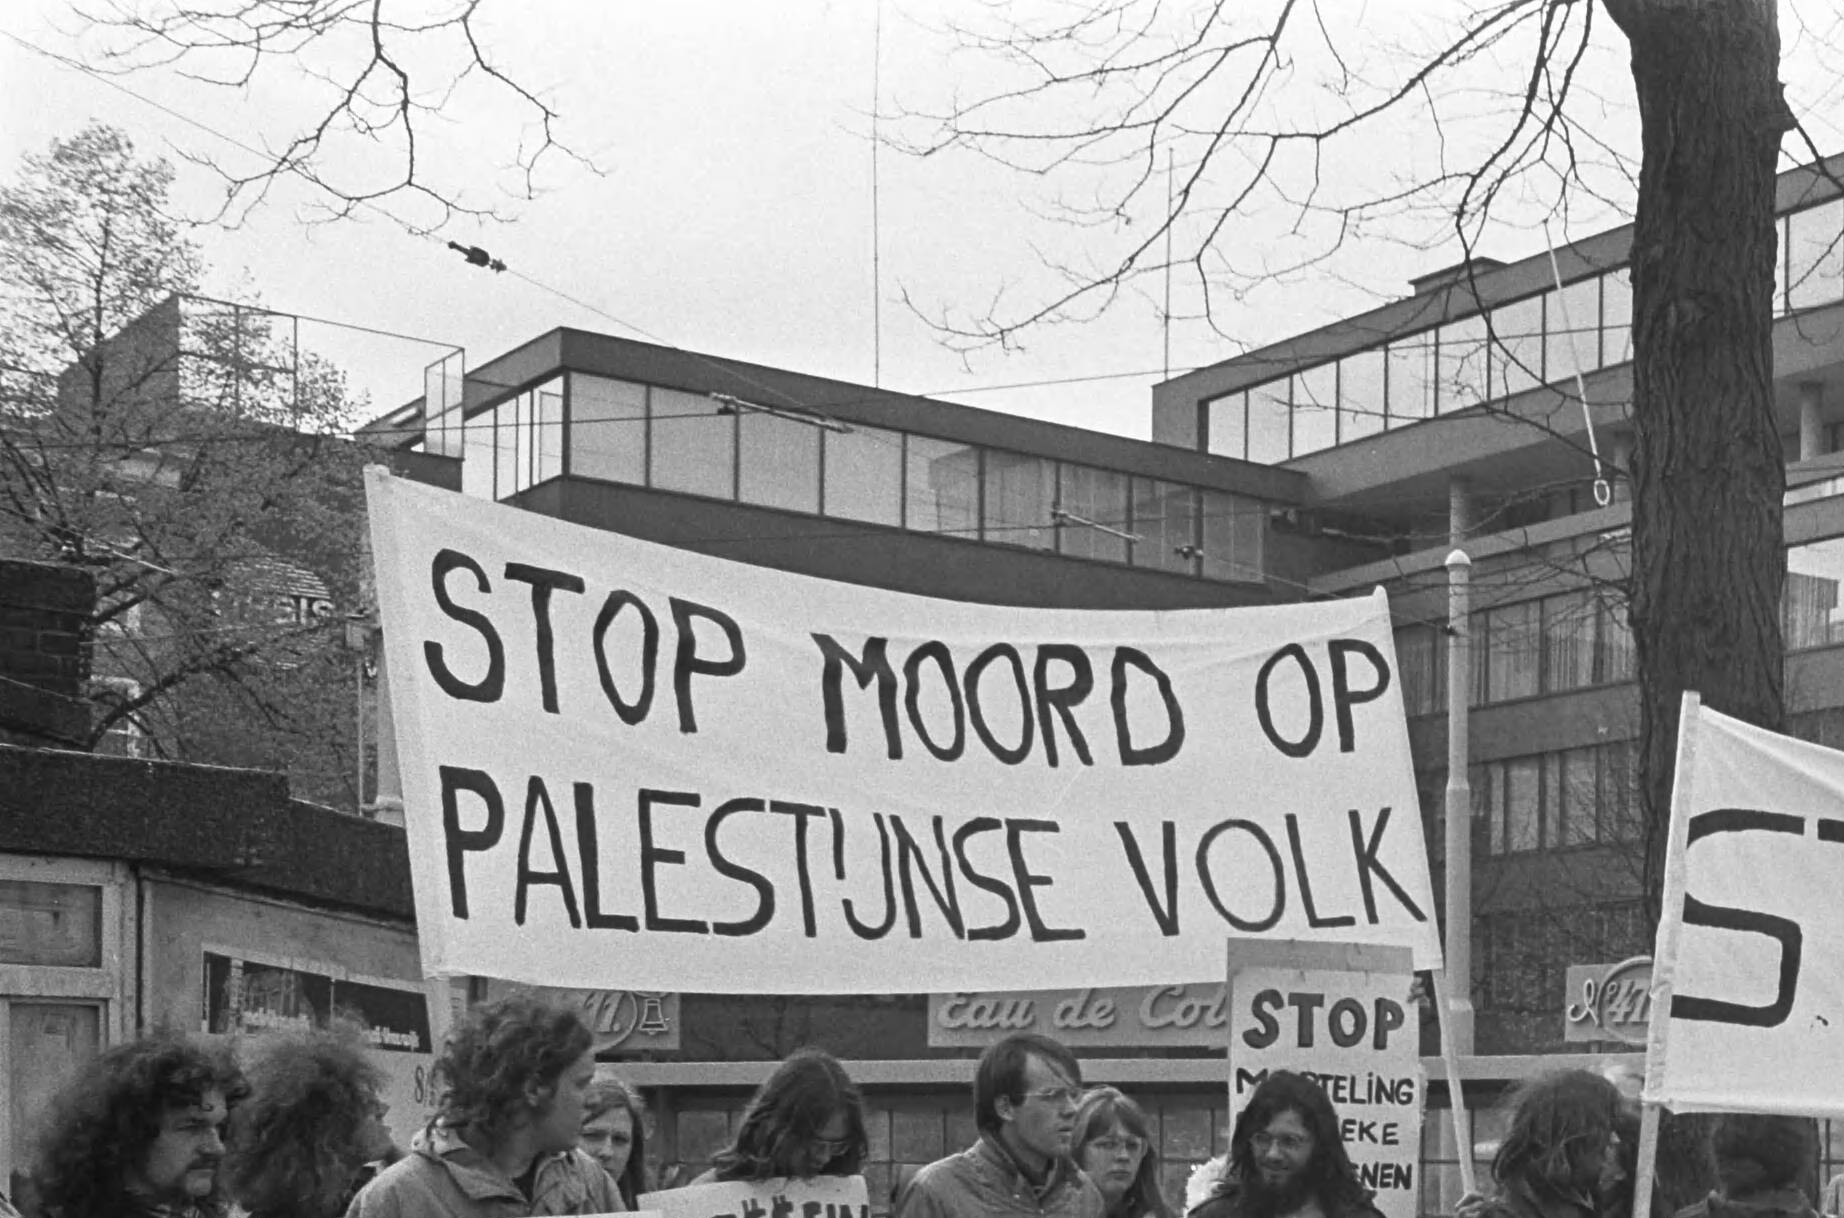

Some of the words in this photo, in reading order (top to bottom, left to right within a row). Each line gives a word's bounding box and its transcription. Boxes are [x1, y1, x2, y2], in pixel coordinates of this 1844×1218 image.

[424, 548, 746, 734] STOP
[812, 633, 1184, 767] MOORD
[1256, 639, 1390, 757] OP
[439, 765, 1085, 942] PALESTIJNSE
[1113, 806, 1428, 936] VOLK
[1053, 988, 1117, 1029] de
[1242, 988, 1405, 1050] STOP
